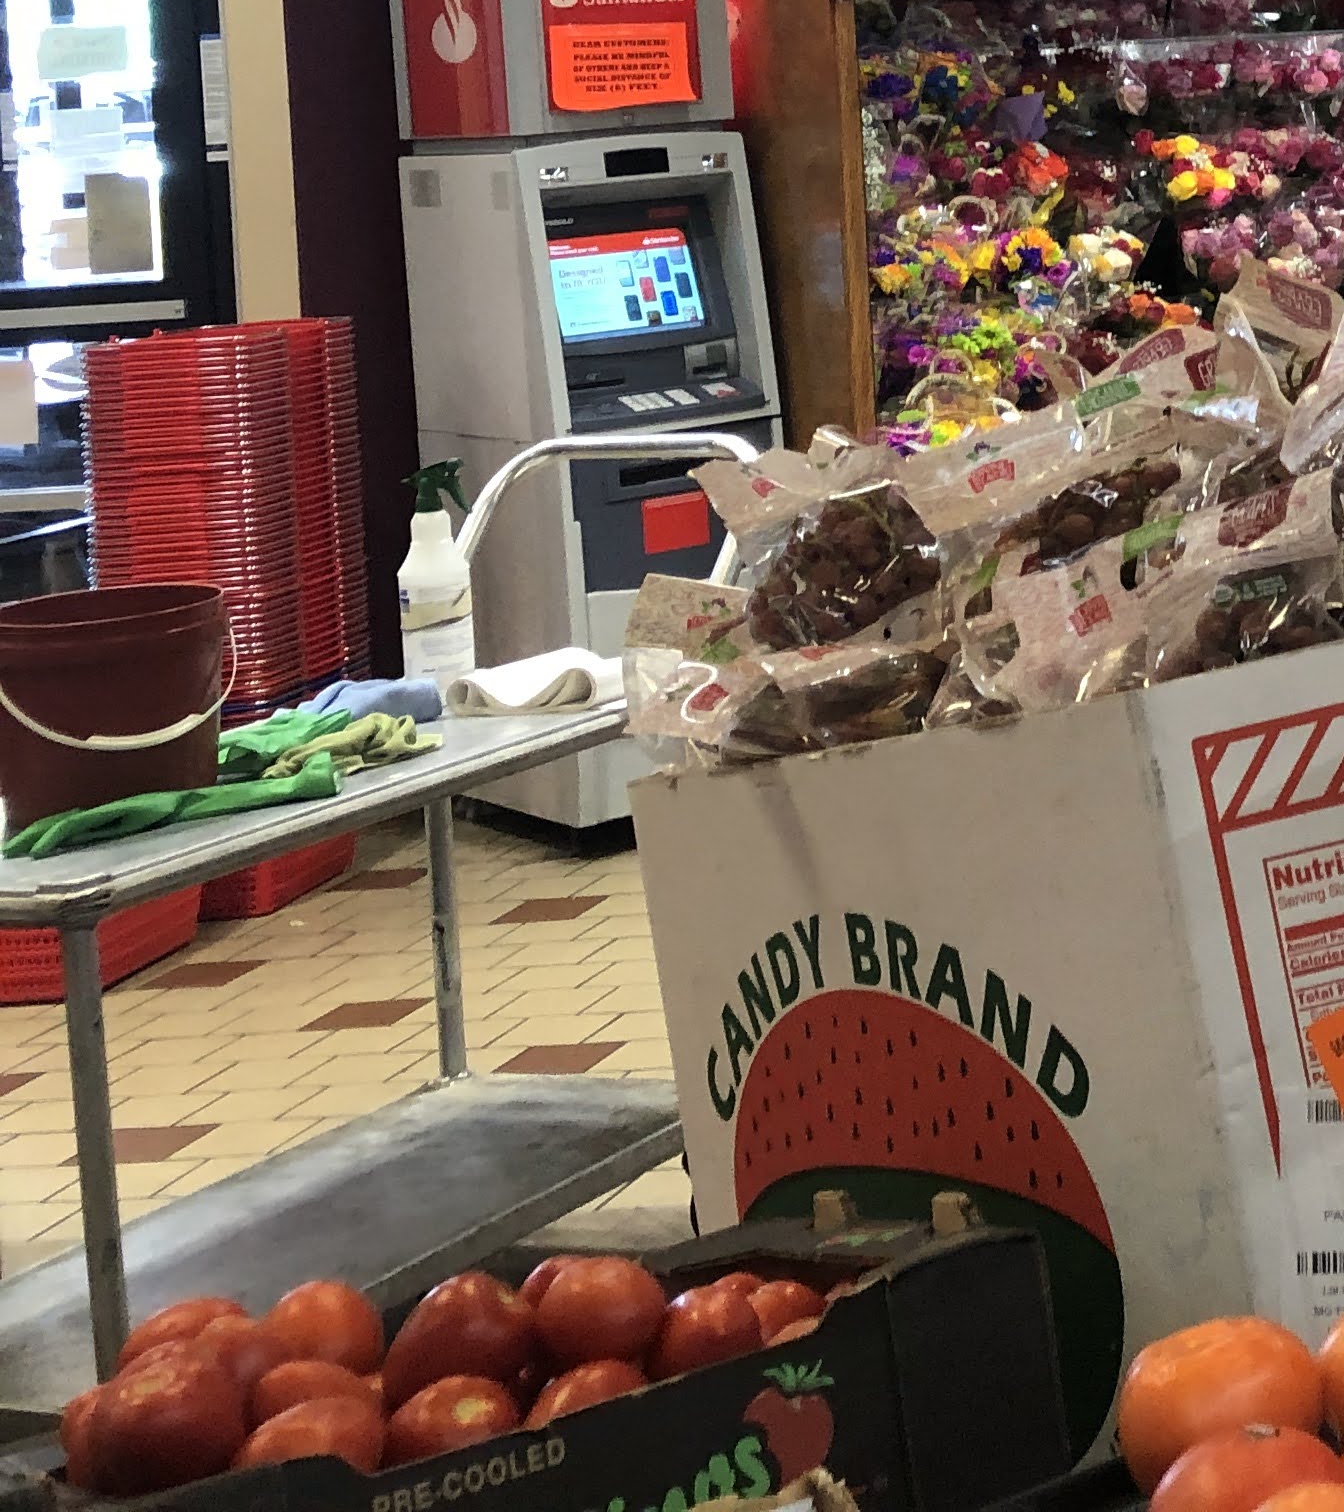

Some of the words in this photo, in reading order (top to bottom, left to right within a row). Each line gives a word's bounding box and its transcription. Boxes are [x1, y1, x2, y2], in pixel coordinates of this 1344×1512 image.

[1278, 890, 1328, 910] Serving
[707, 914, 825, 1122] CANDY
[844, 912, 1091, 1119] BRAND
[1298, 982, 1335, 1005] Total
[371, 1438, 566, 1512] PRE-COOLED
